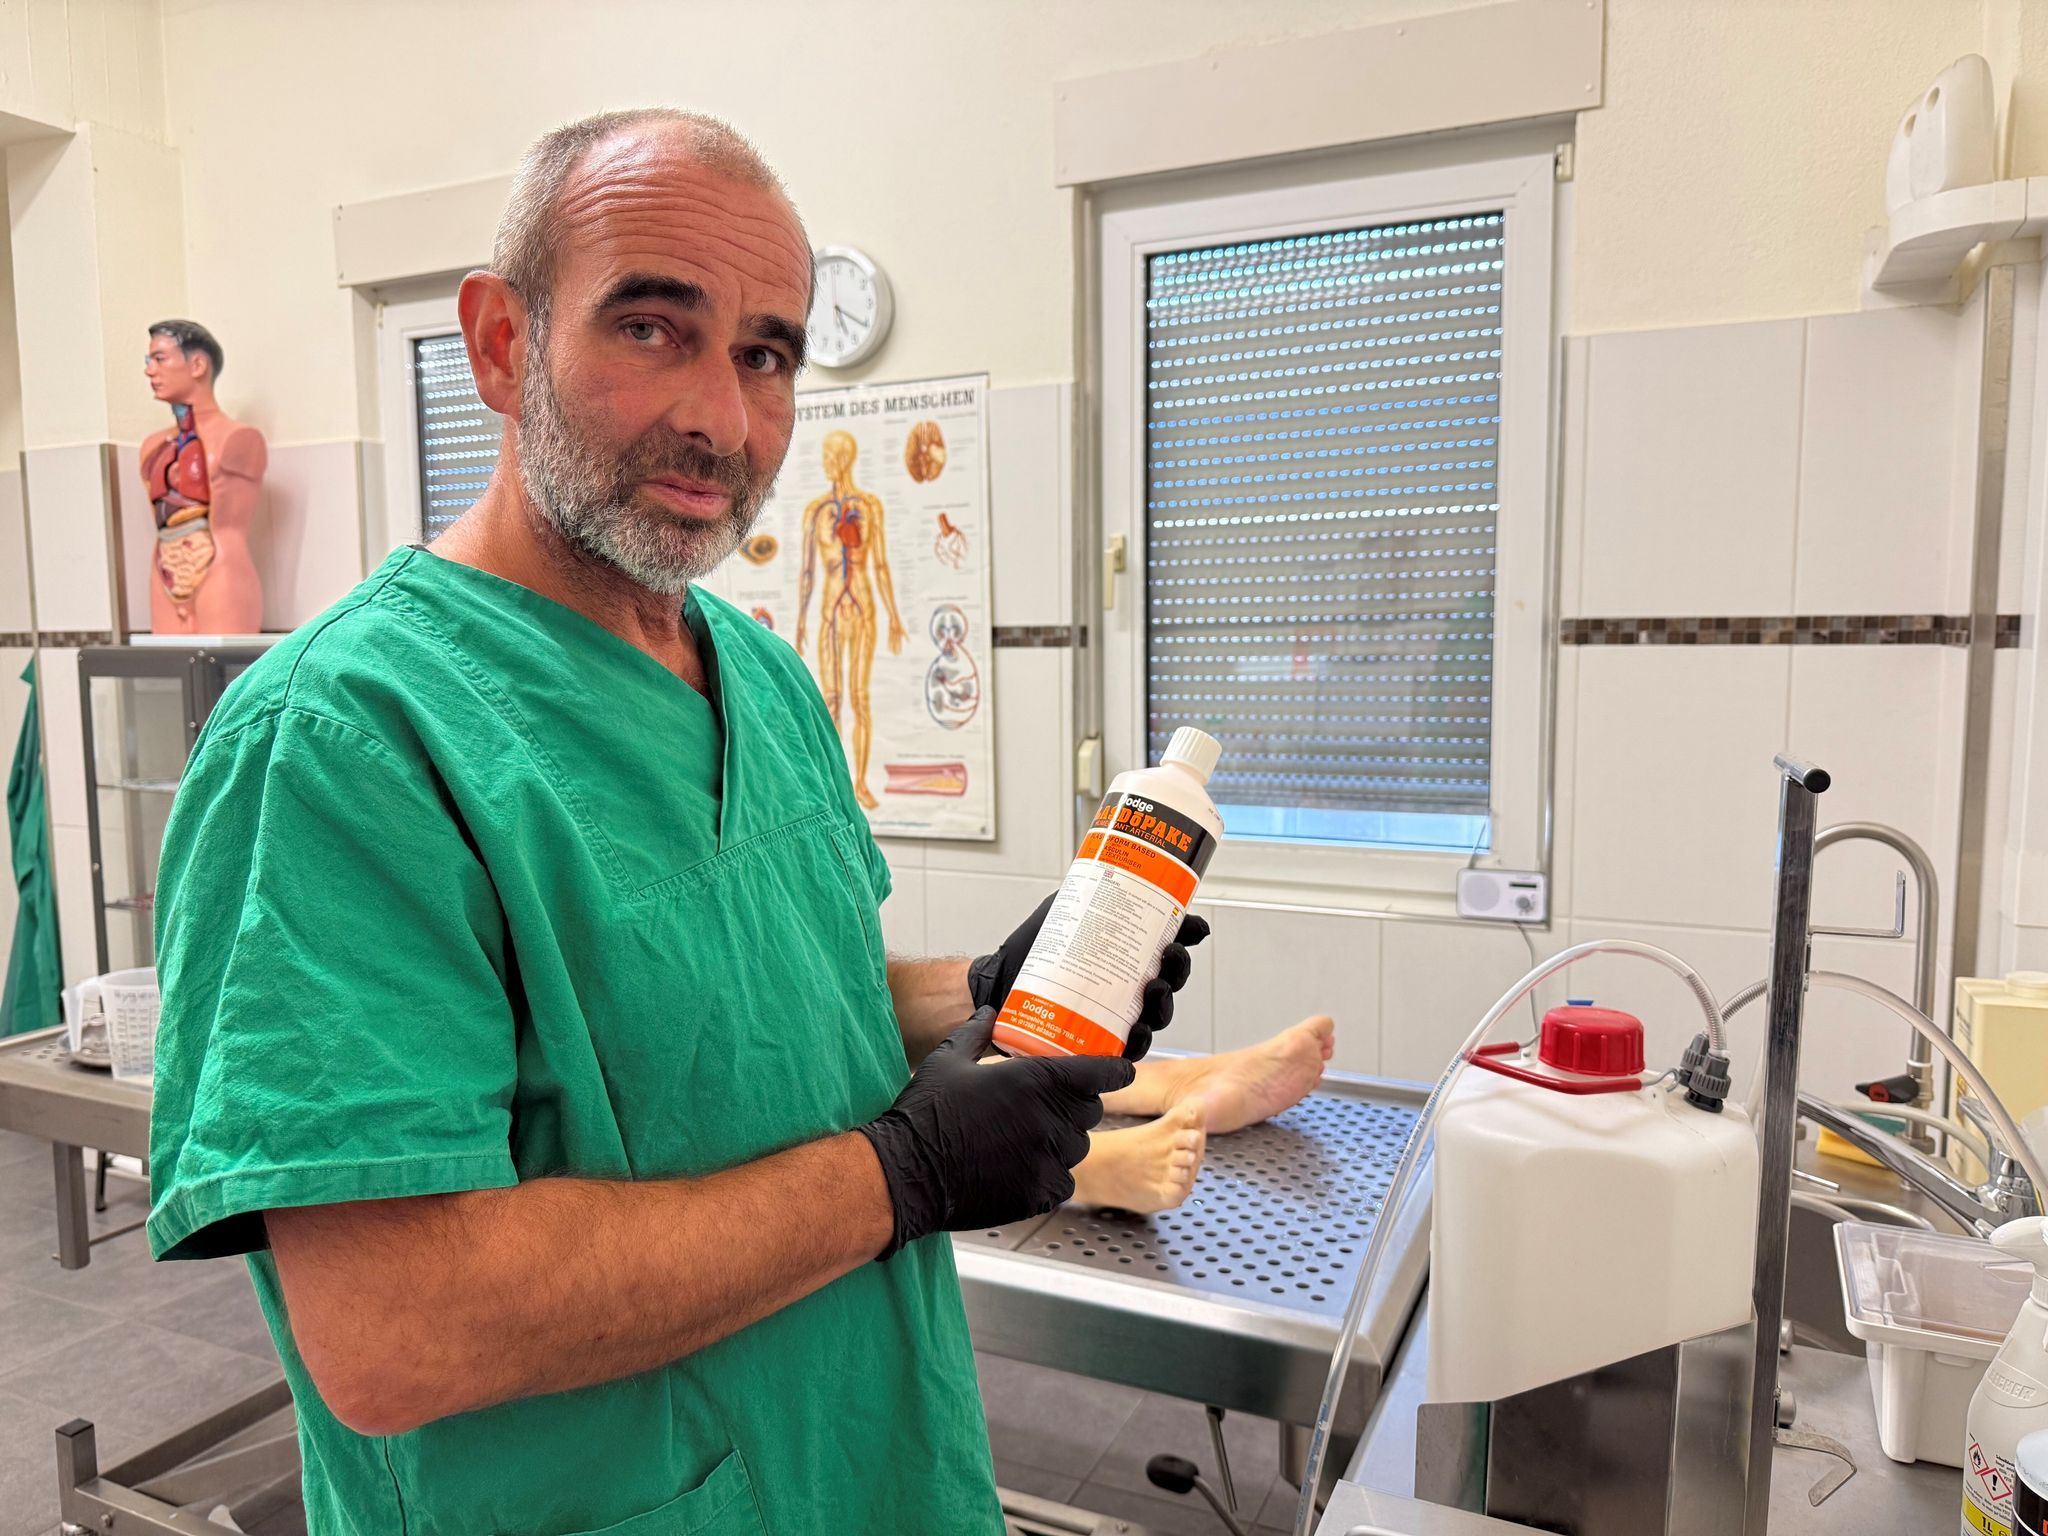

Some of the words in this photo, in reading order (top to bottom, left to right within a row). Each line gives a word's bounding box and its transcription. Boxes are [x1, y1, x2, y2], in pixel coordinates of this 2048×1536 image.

[850, 399, 880, 416] DES
[884, 389, 975, 412] MENSCHEN
[1128, 826, 1166, 847] ARTERIAL
[1130, 843, 1155, 858] BASED
[1021, 999, 1056, 1020] Dodge
